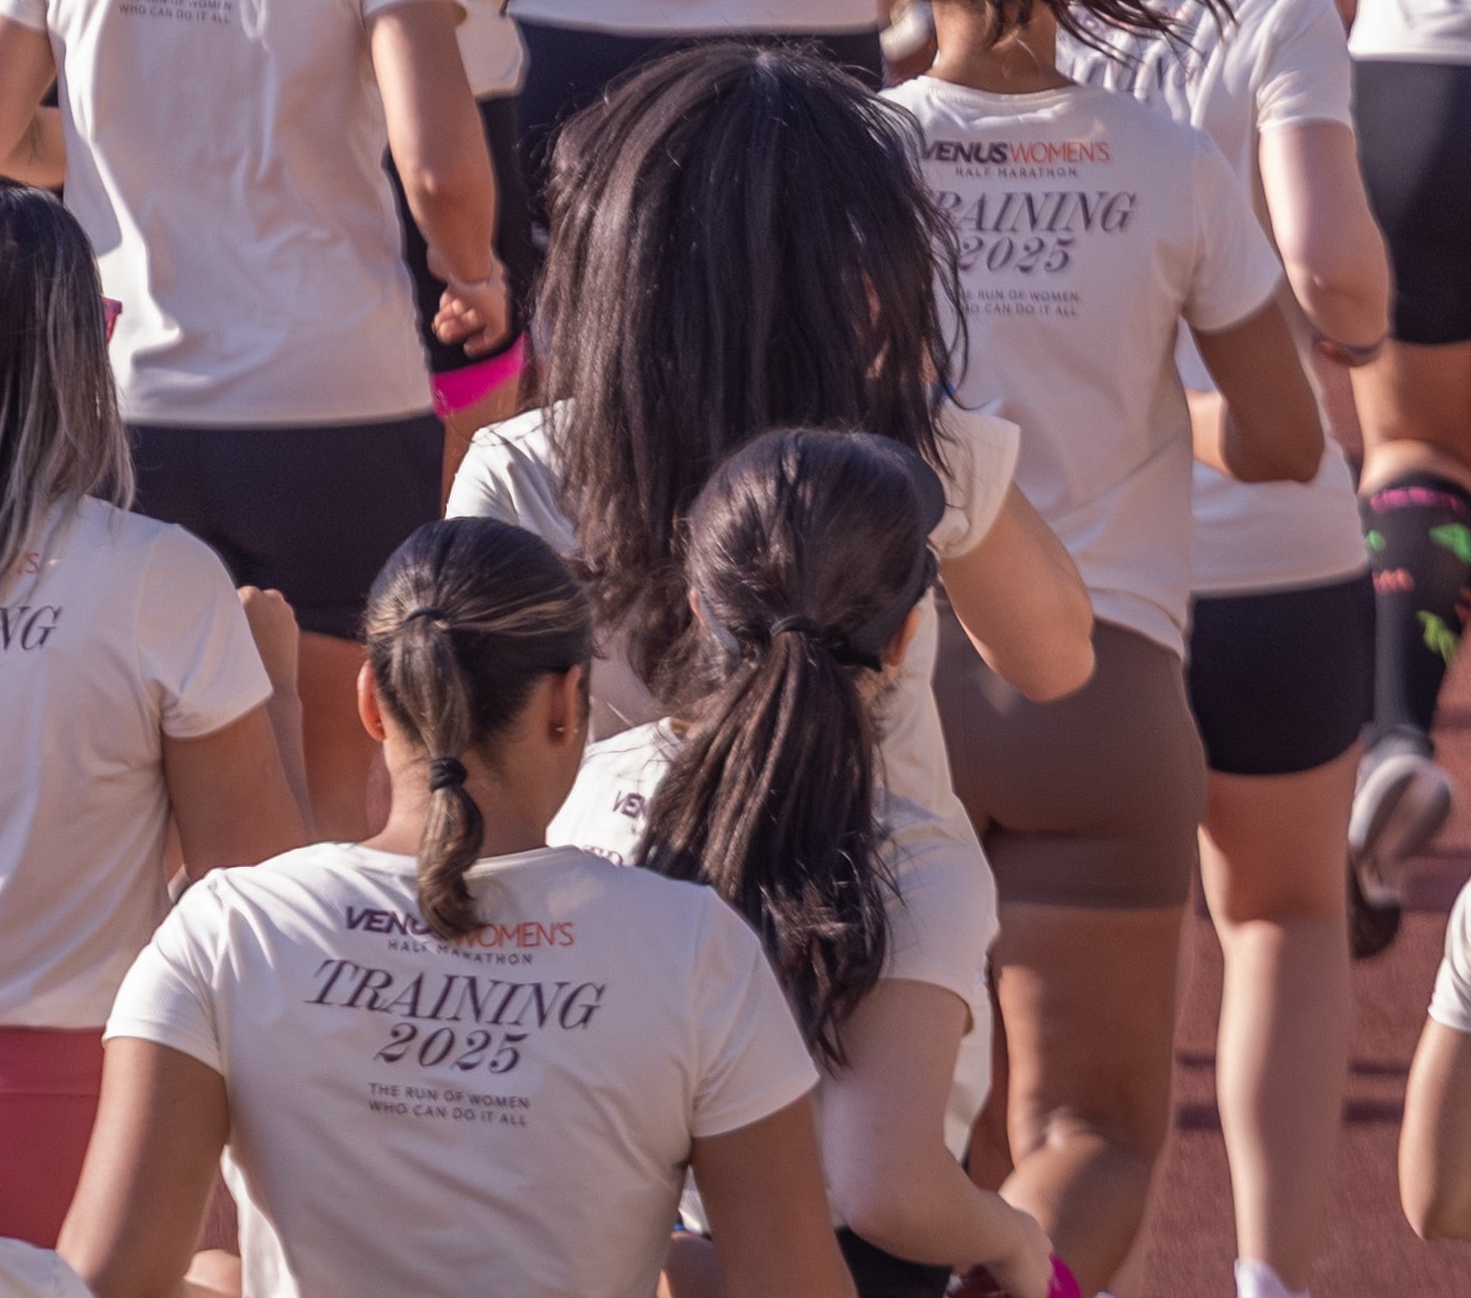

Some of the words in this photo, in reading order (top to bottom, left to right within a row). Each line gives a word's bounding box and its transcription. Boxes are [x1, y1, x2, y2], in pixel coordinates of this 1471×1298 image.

[954, 166, 991, 179] HALF
[996, 166, 1078, 180] MARATHON
[935, 189, 1138, 233] RAINING
[957, 236, 1076, 275] 2025
[977, 289, 1004, 301] RUN
[1008, 289, 1025, 301] OF
[1029, 290, 1079, 302] WOMEN
[984, 303, 1011, 315] CAN
[1016, 303, 1035, 316] DO
[1038, 304, 1050, 316] IT
[1055, 304, 1077, 317] ALL
[387, 940, 428, 955] HALF
[304, 958, 606, 1033] TRAINING
[373, 1022, 530, 1075] 2025
[368, 1081, 401, 1098] THE
[404, 1086, 436, 1100] RUN
[443, 1089, 465, 1102] OF
[469, 1093, 530, 1110] WOMEN
[368, 1100, 408, 1115] WHO
[412, 1104, 447, 1118] CAN
[452, 1106, 475, 1121] DO
[481, 1110, 494, 1122] IT
[499, 1113, 527, 1127] ALL
